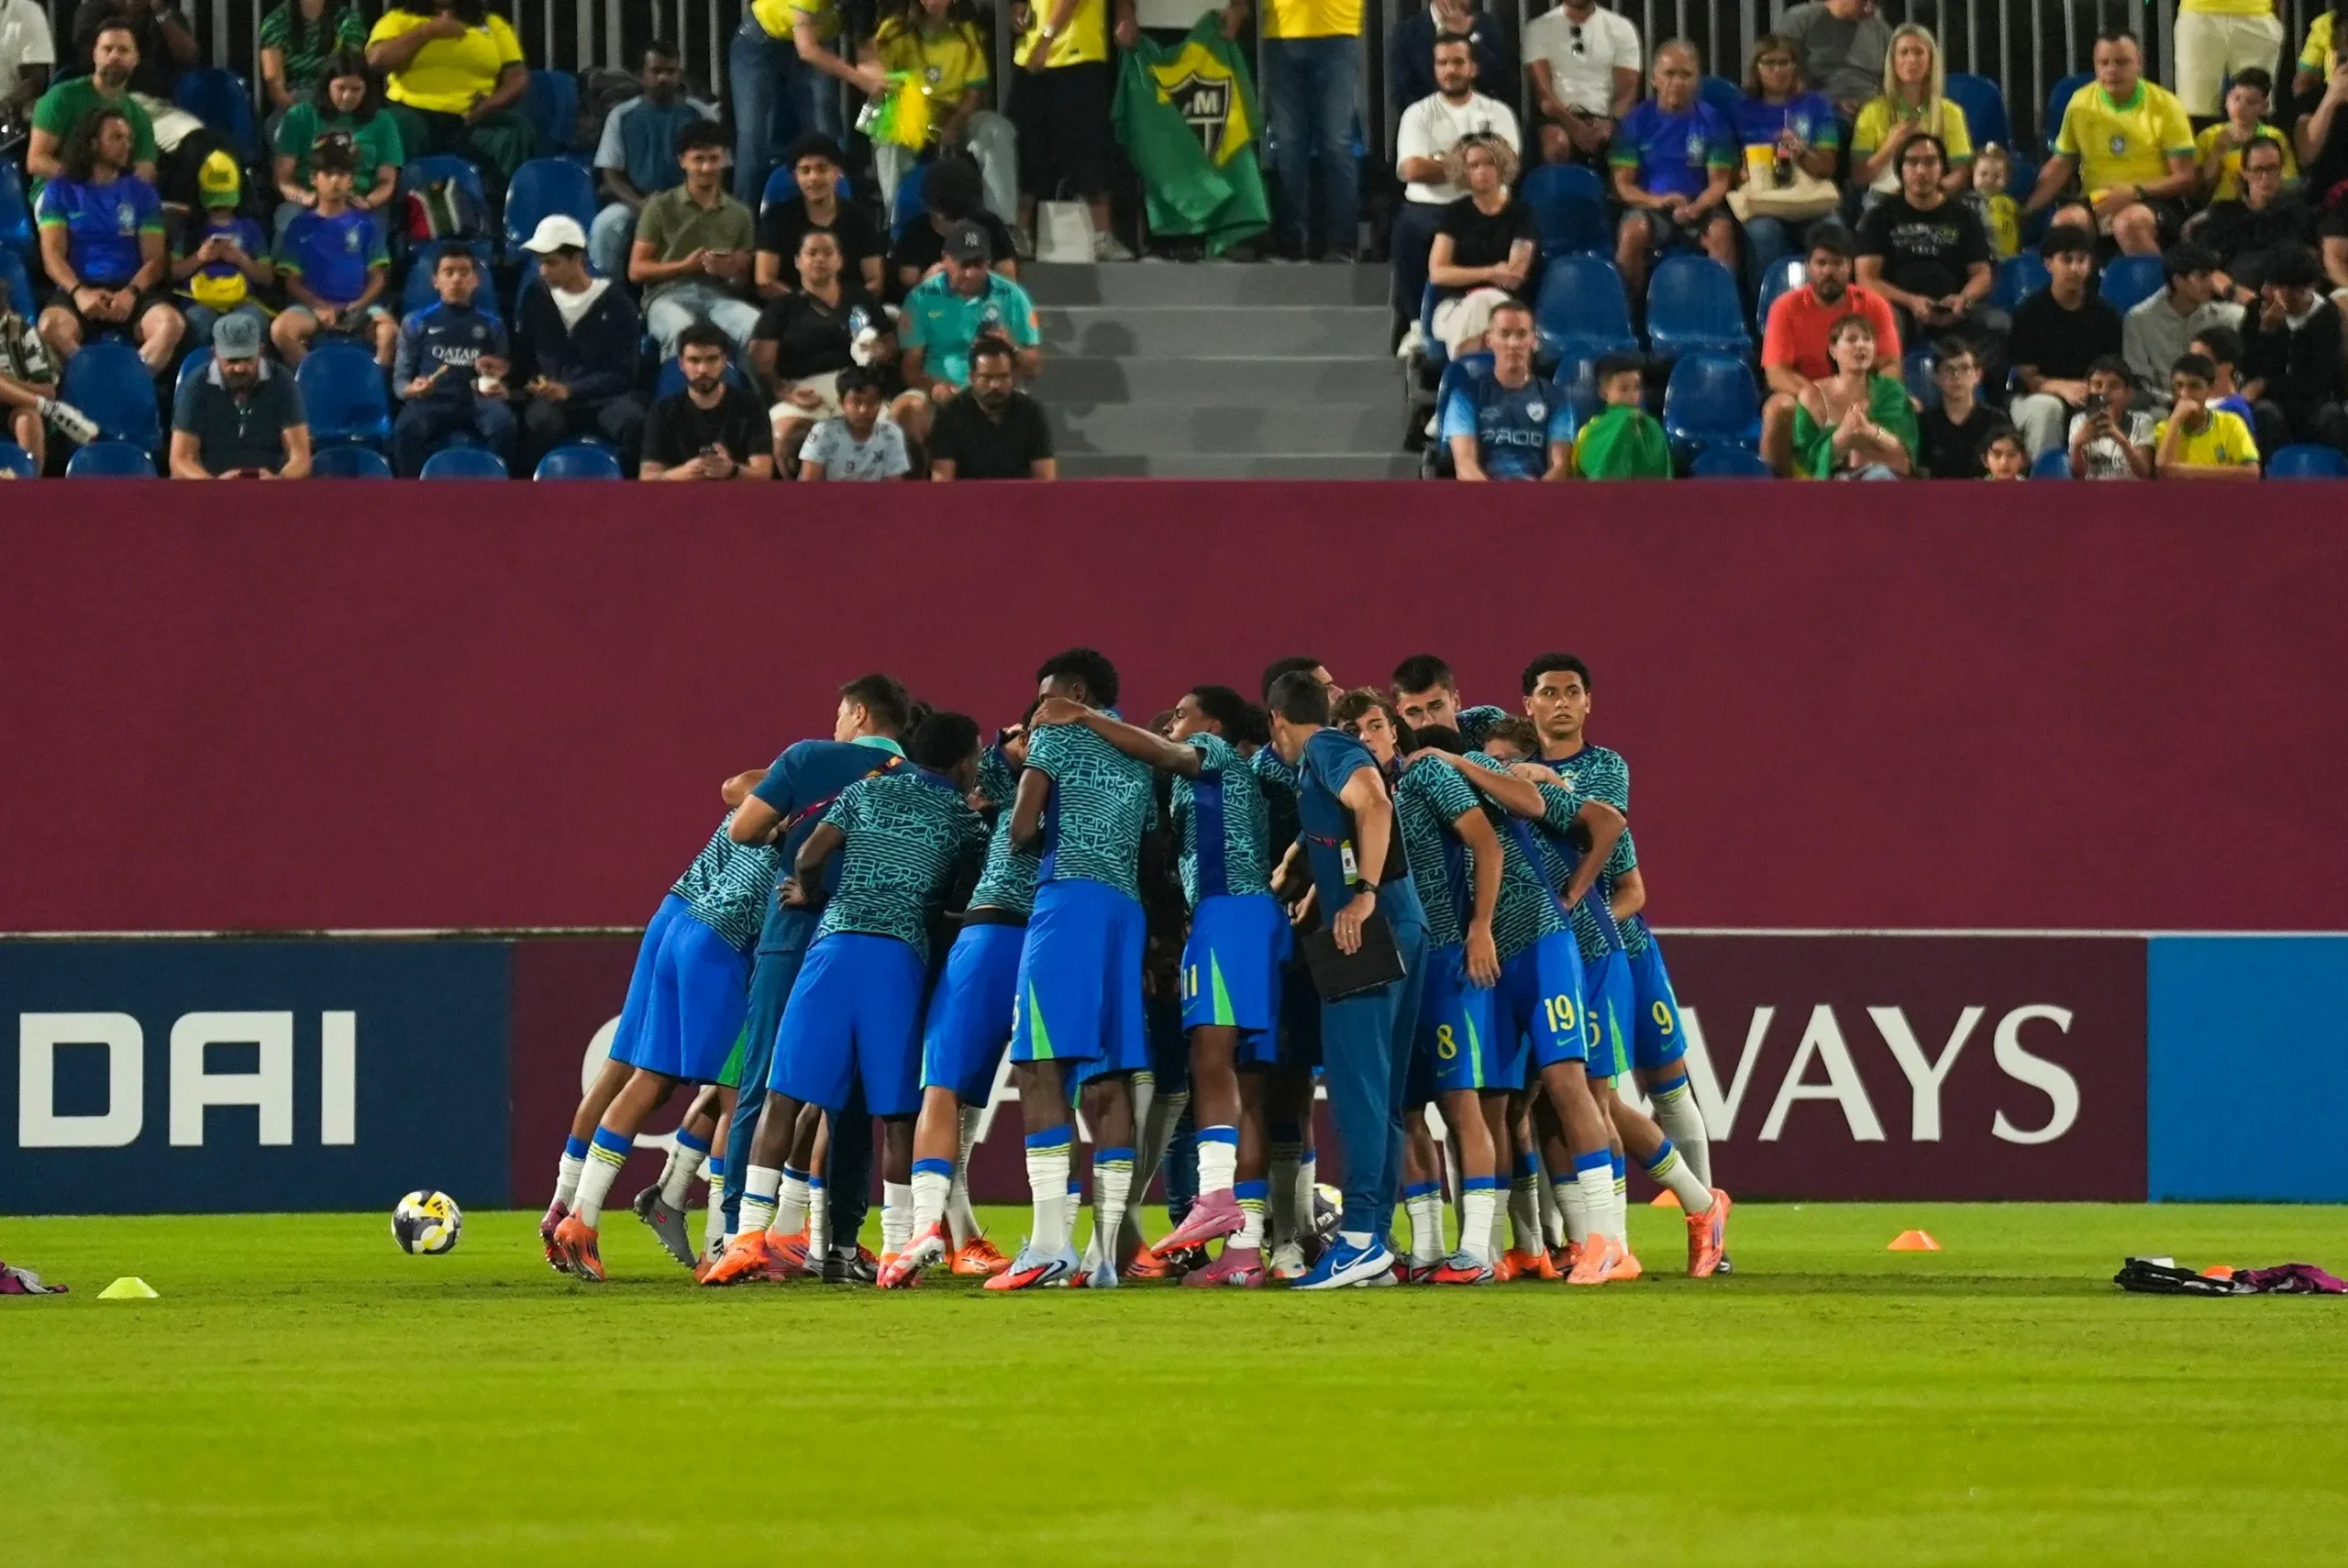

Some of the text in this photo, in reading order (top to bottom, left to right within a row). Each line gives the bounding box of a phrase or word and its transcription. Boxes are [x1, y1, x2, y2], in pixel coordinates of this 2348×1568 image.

[432, 345, 481, 359] QATAR
[1183, 964, 1198, 1000] 11
[1544, 994, 1575, 1032] 19
[1652, 1000, 1674, 1035] 9
[1436, 1024, 1457, 1060] 8
[18, 1010, 356, 1148] DAI
